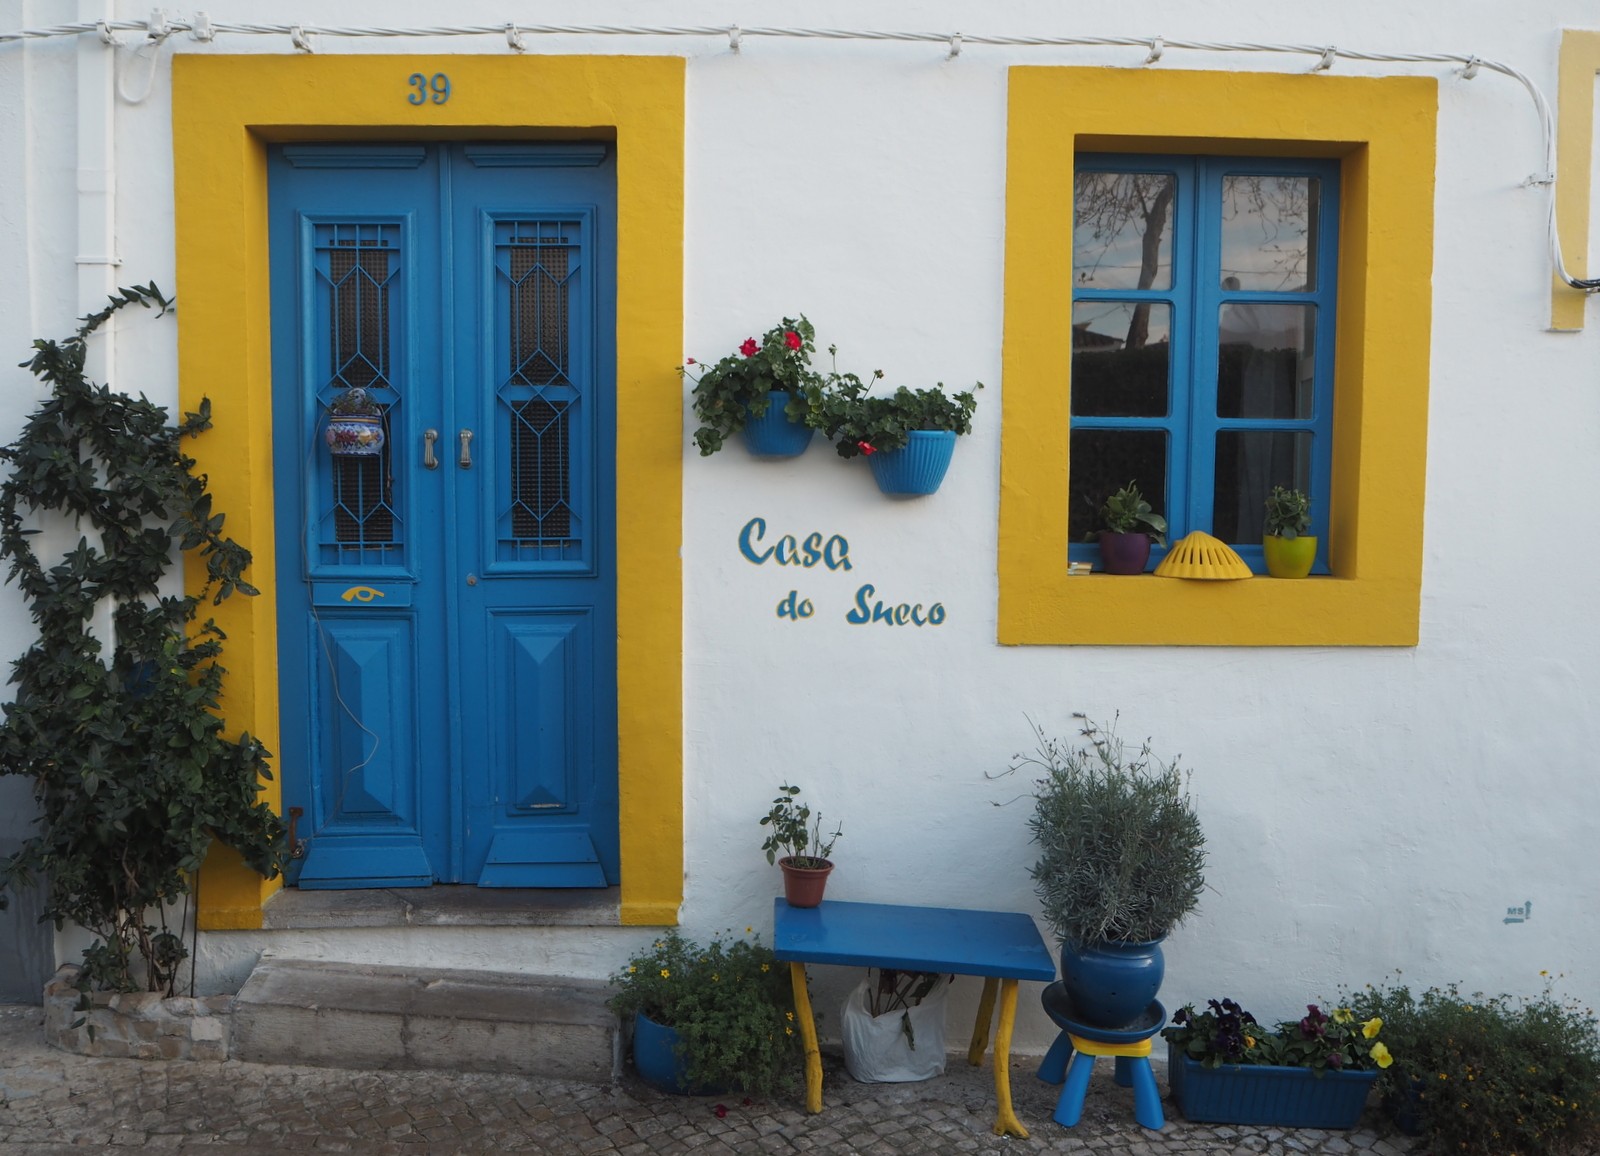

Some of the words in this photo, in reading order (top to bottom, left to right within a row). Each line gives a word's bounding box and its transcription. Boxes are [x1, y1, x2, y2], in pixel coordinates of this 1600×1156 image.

[408, 72, 451, 105] 39
[738, 517, 852, 571] Casa
[776, 590, 815, 621] do
